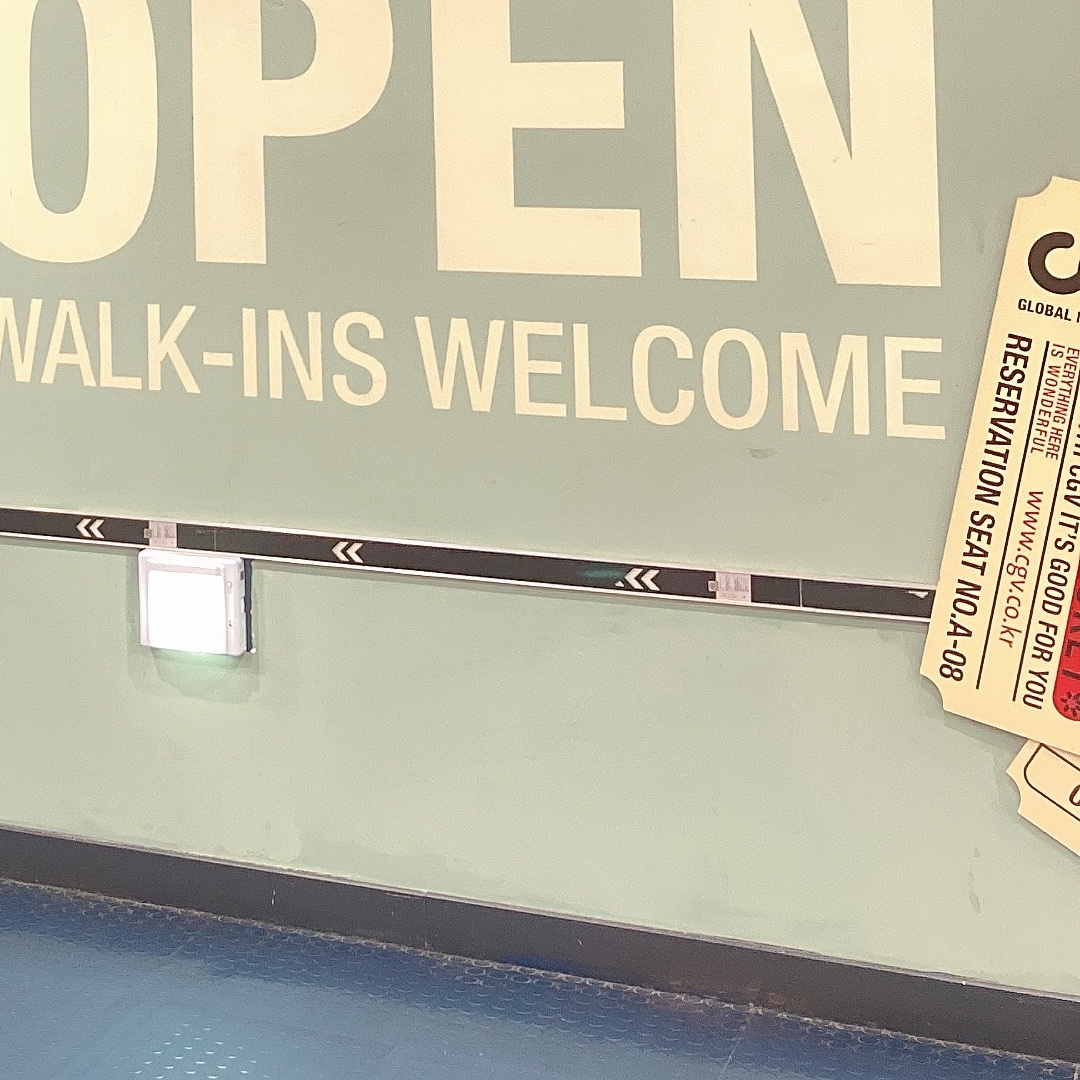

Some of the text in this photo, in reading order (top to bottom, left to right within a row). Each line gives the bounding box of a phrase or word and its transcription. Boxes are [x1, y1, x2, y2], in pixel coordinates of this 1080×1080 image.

[1018, 298, 1072, 322] GLOBAL
[415, 315, 947, 440] WELCOME
[1030, 343, 1066, 454] IS WONDERFUL
[1045, 347, 1080, 461] EVERYTHING HERE
[939, 333, 1033, 682] RESERVATION SEAT NO.A-08
[1054, 511, 1080, 553] IT'S
[998, 491, 1044, 649] www.cgv.co.kr
[1041, 558, 1071, 616] GOOD
[1031, 620, 1059, 663] FOR
[1022, 669, 1050, 710] YOU
